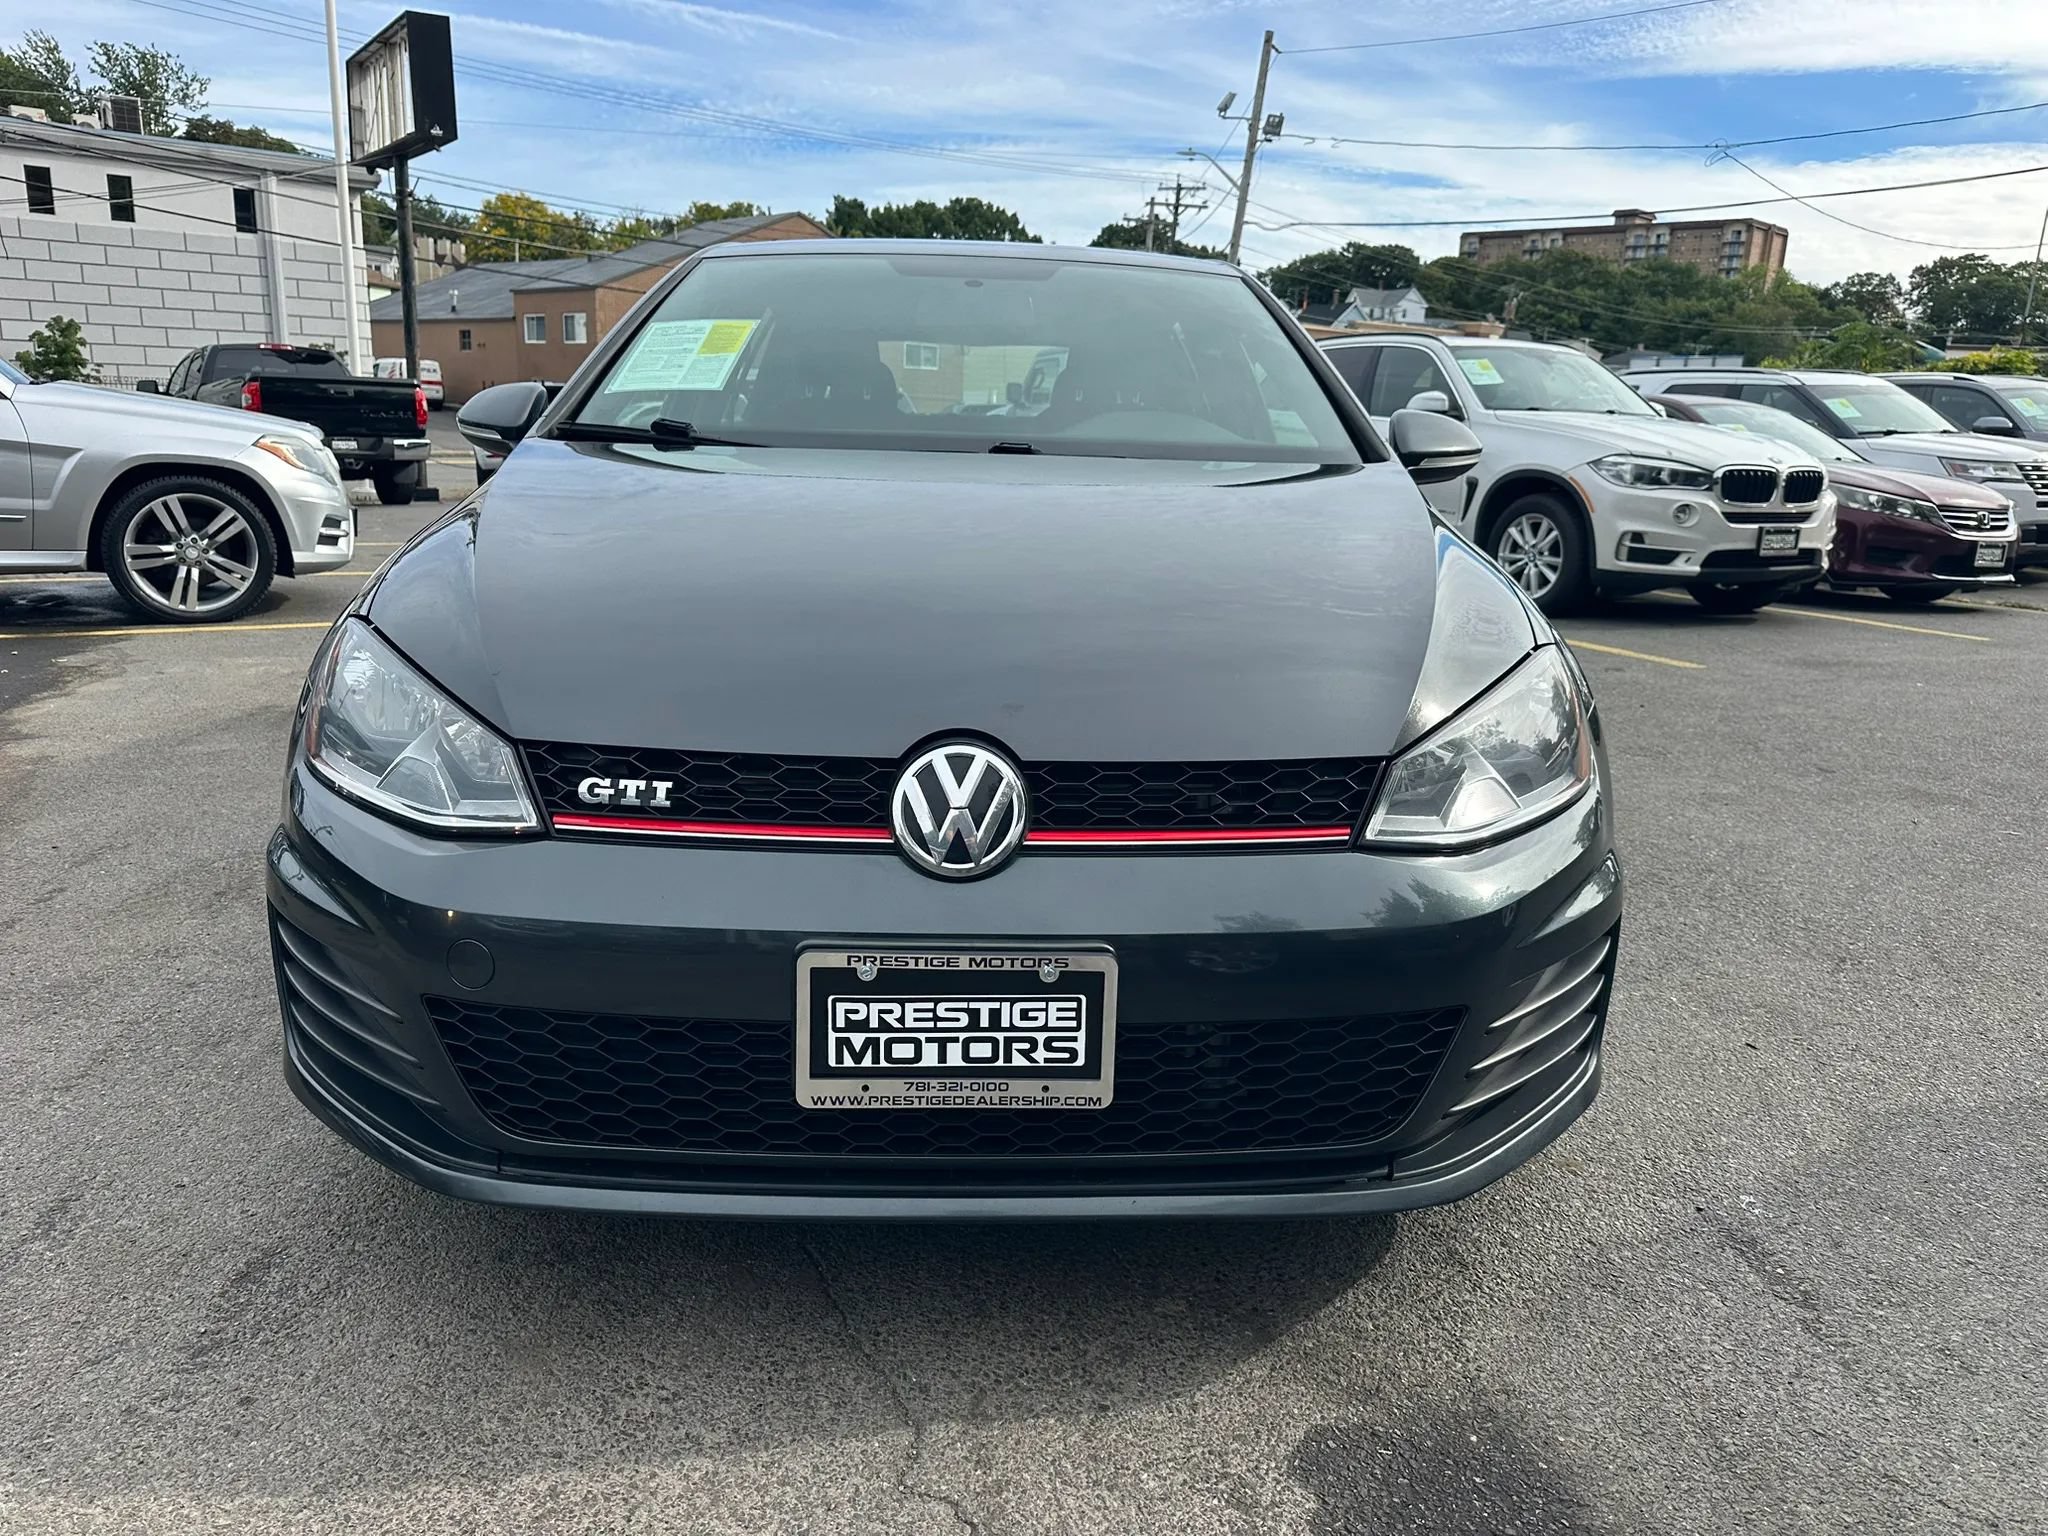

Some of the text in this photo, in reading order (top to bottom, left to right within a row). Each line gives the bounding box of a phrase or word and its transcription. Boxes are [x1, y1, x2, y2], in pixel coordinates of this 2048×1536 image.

[577, 776, 674, 808] GTI
[847, 954, 1070, 970] PRESTIGE MOTORS
[836, 1002, 1078, 1028] PRESTIGE
[835, 1036, 1079, 1065] MOTORS
[904, 1082, 1010, 1093] 781-321-0100
[811, 1096, 1102, 1107] WWW.PRESTIGEDEALERSHIP.COM
